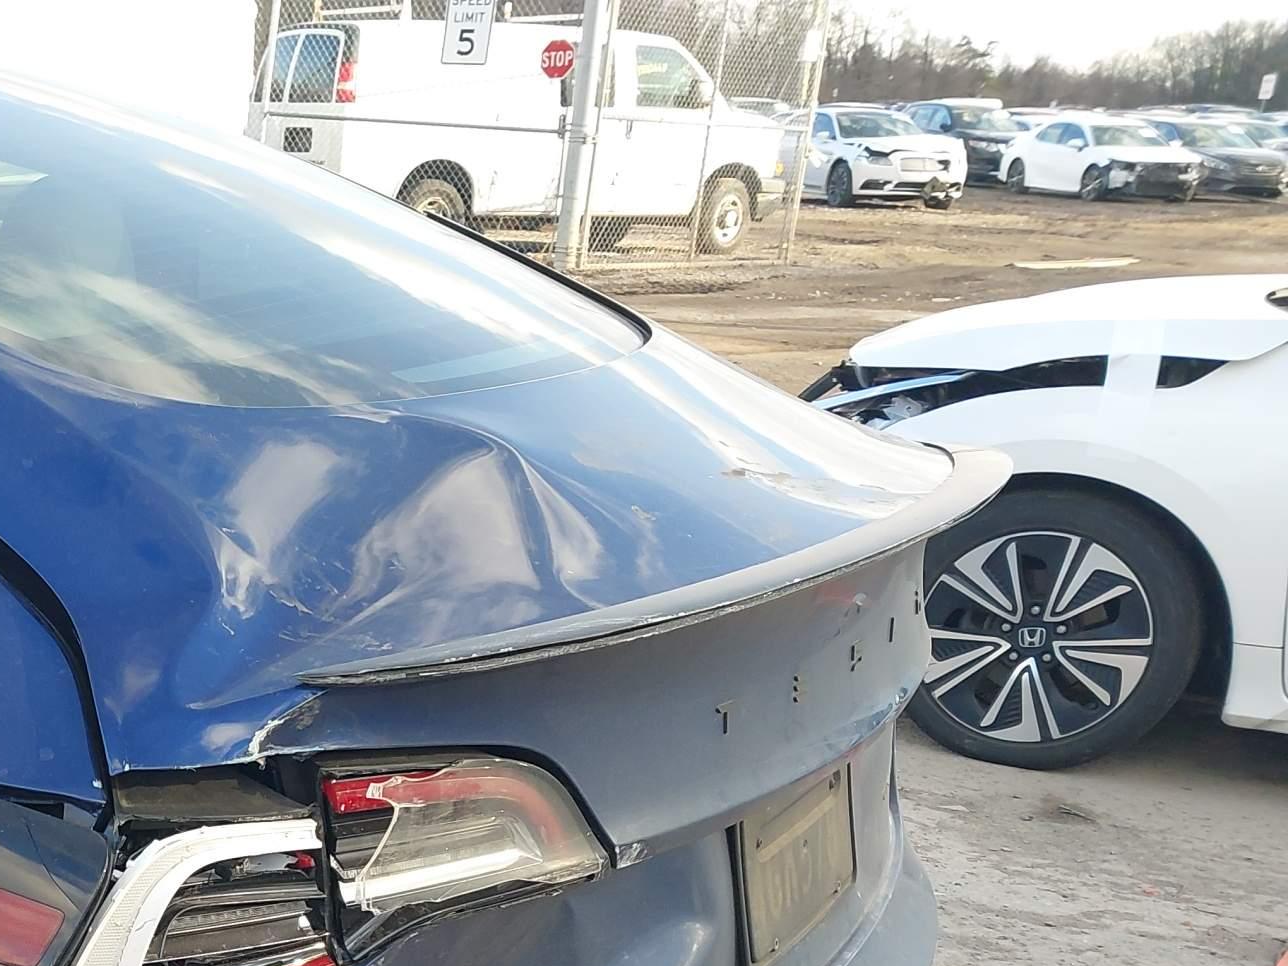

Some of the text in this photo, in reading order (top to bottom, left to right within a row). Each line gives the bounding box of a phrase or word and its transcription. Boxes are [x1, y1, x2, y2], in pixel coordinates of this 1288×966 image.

[454, 12, 486, 23] LIMIT
[456, 28, 475, 56] 5
[542, 50, 573, 68] STOP
